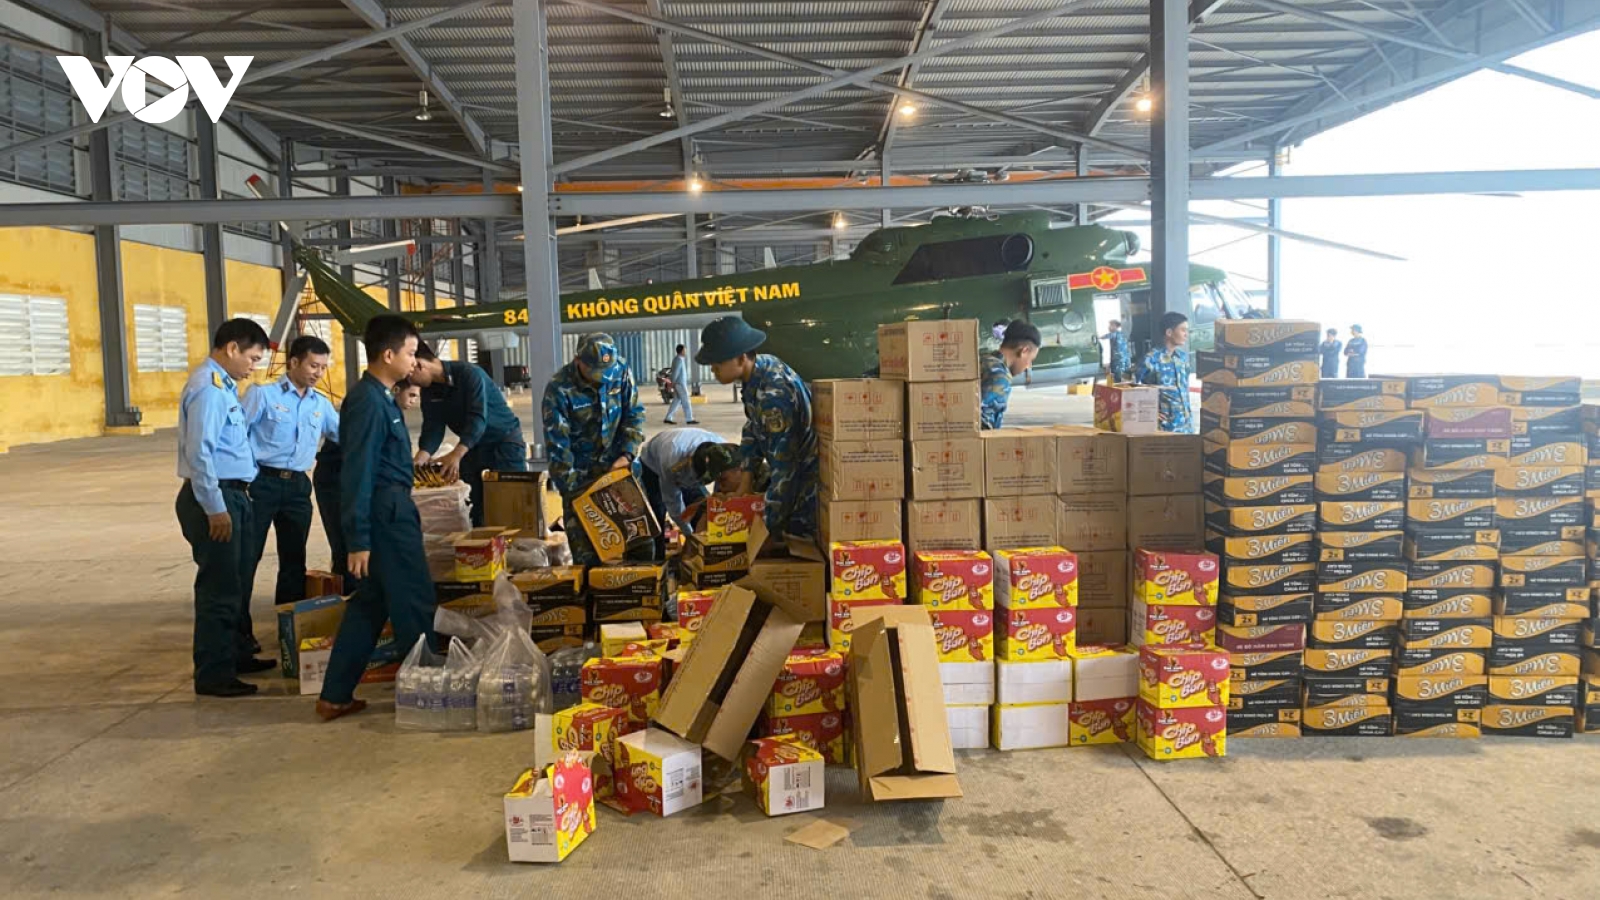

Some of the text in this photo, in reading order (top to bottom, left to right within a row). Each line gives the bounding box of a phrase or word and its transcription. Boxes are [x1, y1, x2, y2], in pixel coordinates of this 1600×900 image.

[504, 282, 800, 324] 84 KHÔNG QUÂN VIỆT NAM
